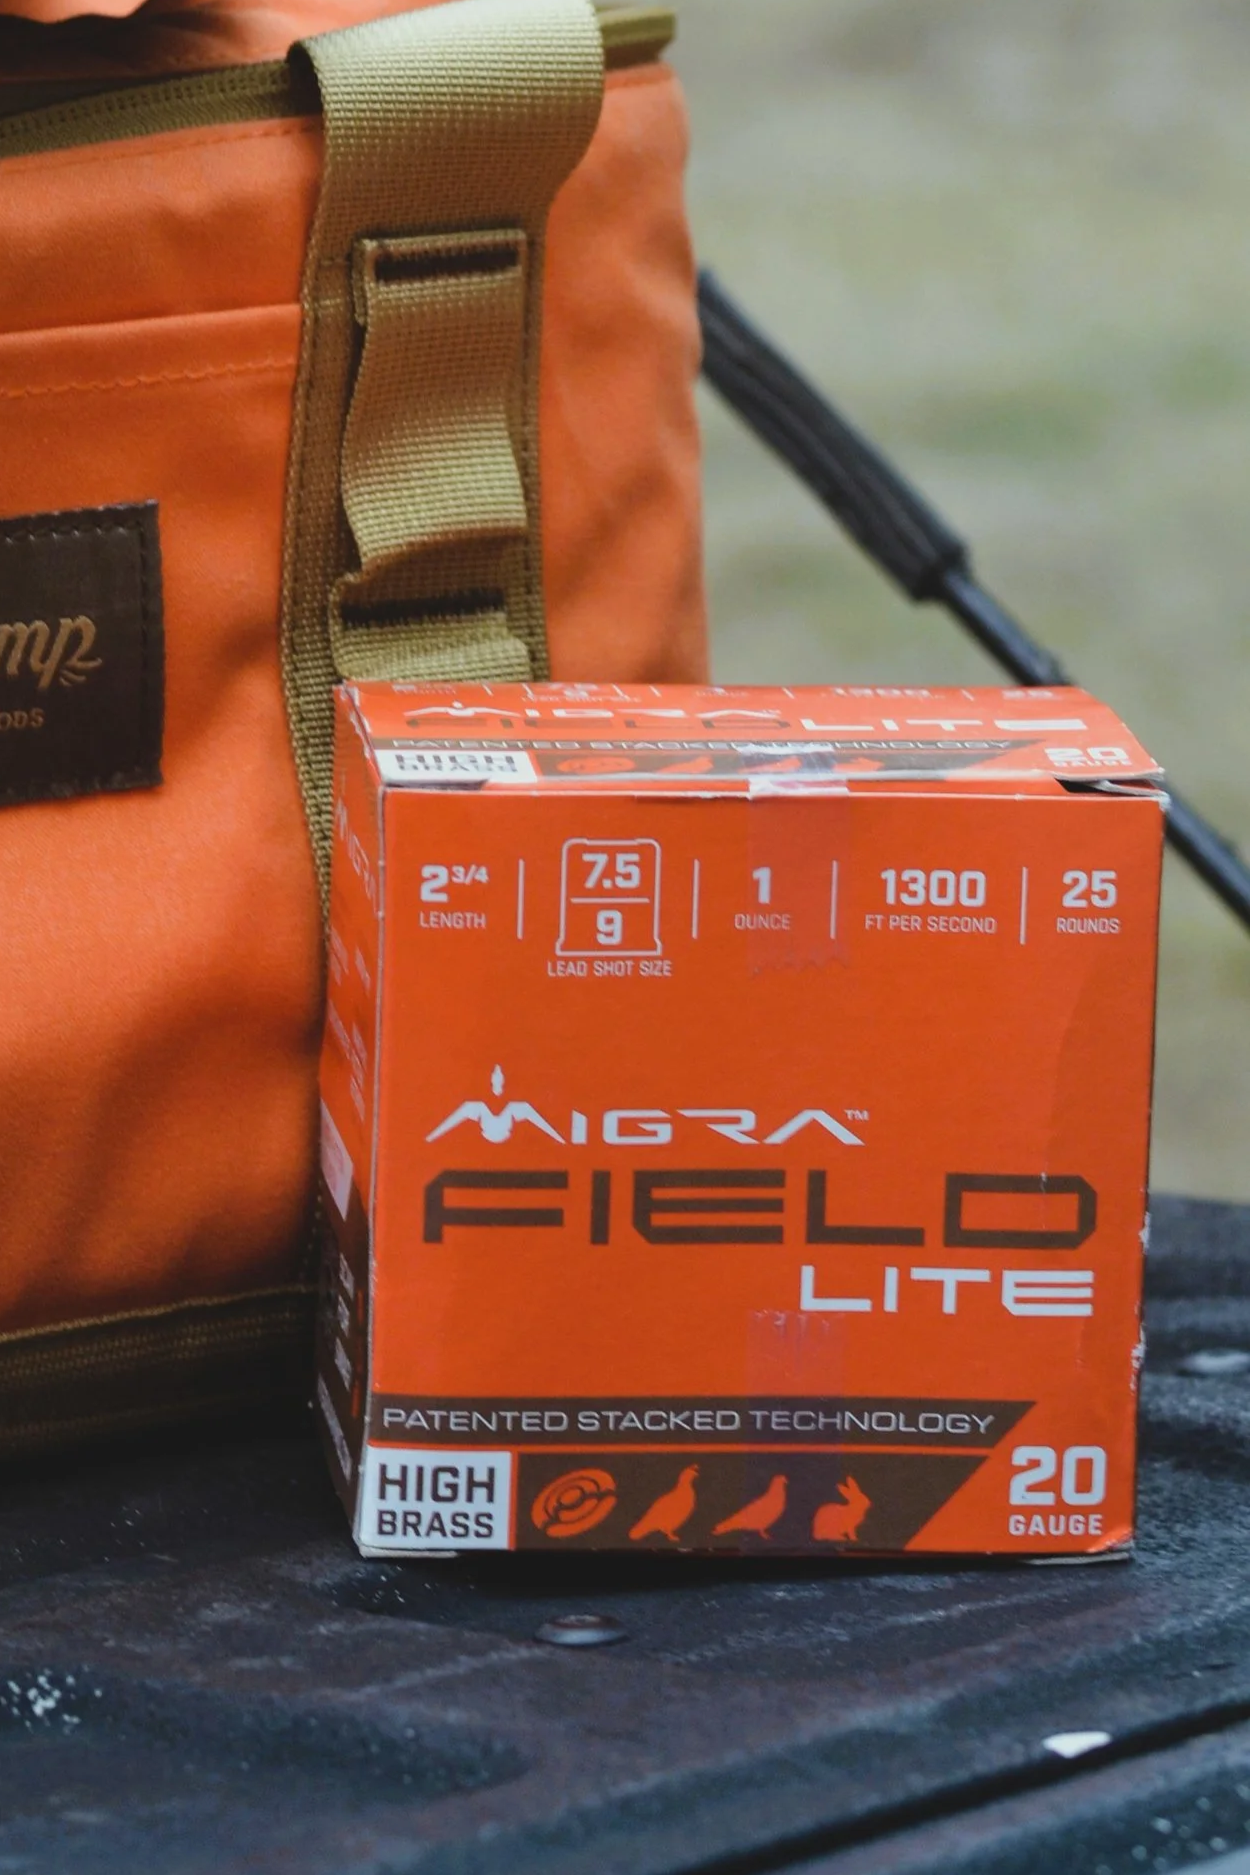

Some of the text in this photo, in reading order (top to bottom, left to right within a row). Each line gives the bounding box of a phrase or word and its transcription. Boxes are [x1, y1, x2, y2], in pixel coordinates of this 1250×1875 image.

[799, 718, 1088, 731] LITE
[392, 740, 581, 749] PATENTED
[582, 853, 640, 889] 7.5
[752, 866, 771, 904] 1
[880, 869, 987, 908] 1300
[1062, 870, 1117, 908] 25
[419, 911, 487, 929] LENGTH
[596, 910, 623, 945] 9
[734, 913, 791, 930] OUNCE
[864, 914, 998, 934] FT PER SECOND
[1056, 917, 1120, 934] ROUNDS
[547, 960, 672, 976] LEAD SHOT SIZE
[423, 1168, 1098, 1250] FIELD
[800, 1265, 1094, 1317] LITE
[383, 1407, 995, 1434] PATENTED STACKED TECHNOLOGY
[378, 1463, 496, 1503] HIGH
[1009, 1445, 1107, 1506] 20
[377, 1510, 494, 1539] BRASS
[1008, 1514, 1103, 1536] GAUGE
